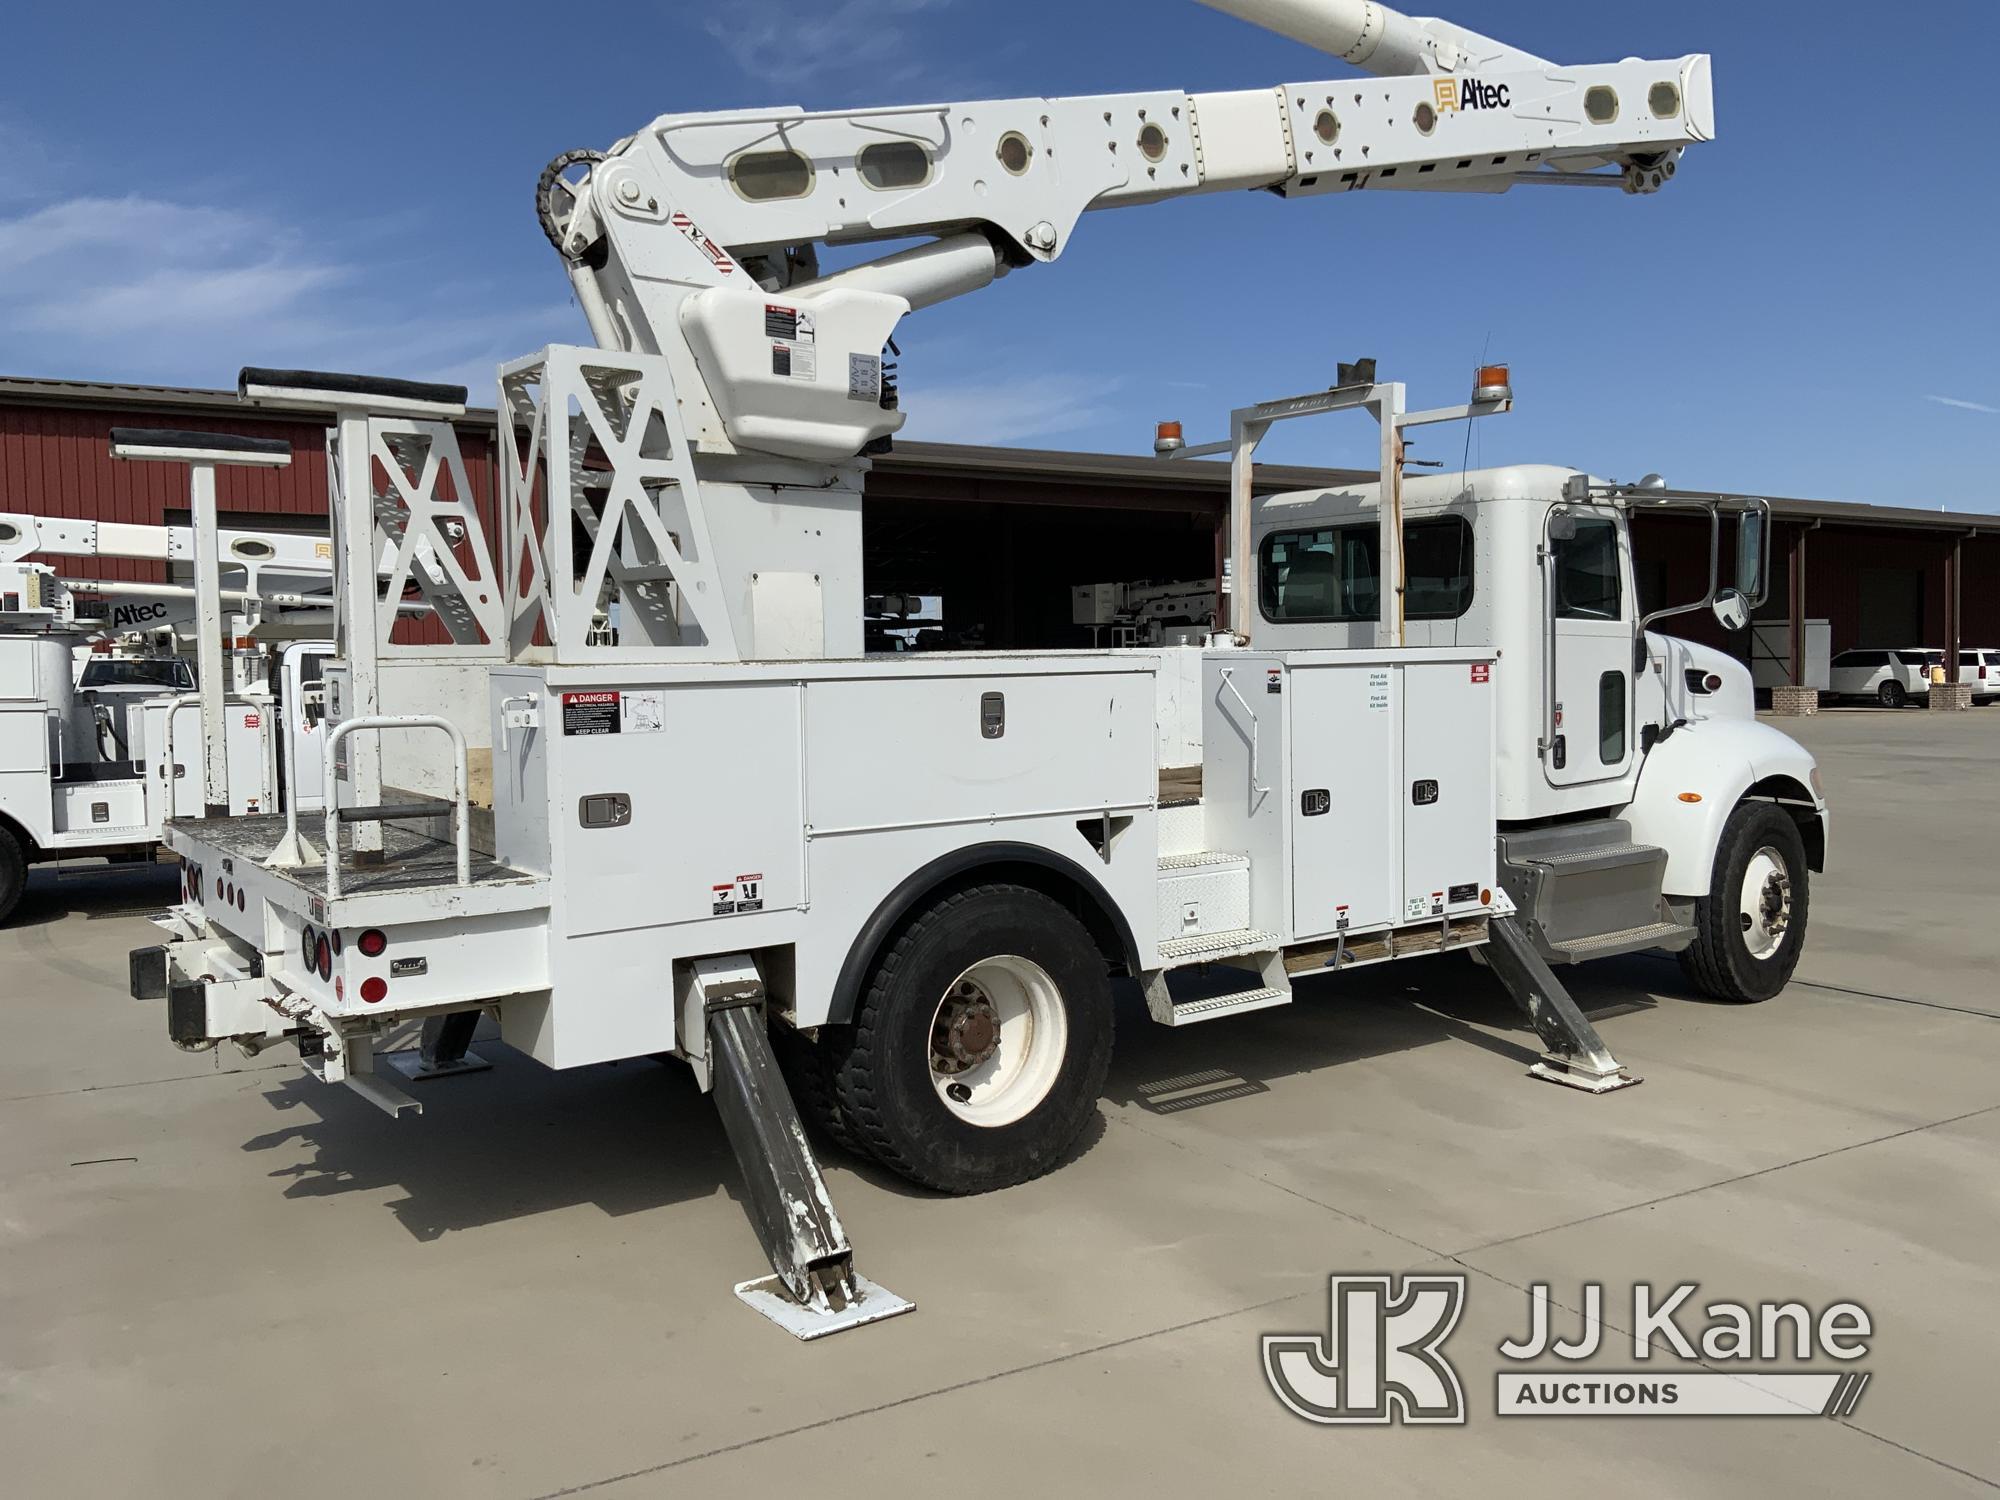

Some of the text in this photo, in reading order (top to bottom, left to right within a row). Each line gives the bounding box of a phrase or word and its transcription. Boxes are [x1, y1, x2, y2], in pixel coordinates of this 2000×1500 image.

[1460, 78, 1510, 110] Altec
[113, 602, 167, 628] Altec
[579, 693, 613, 703] DANGER
